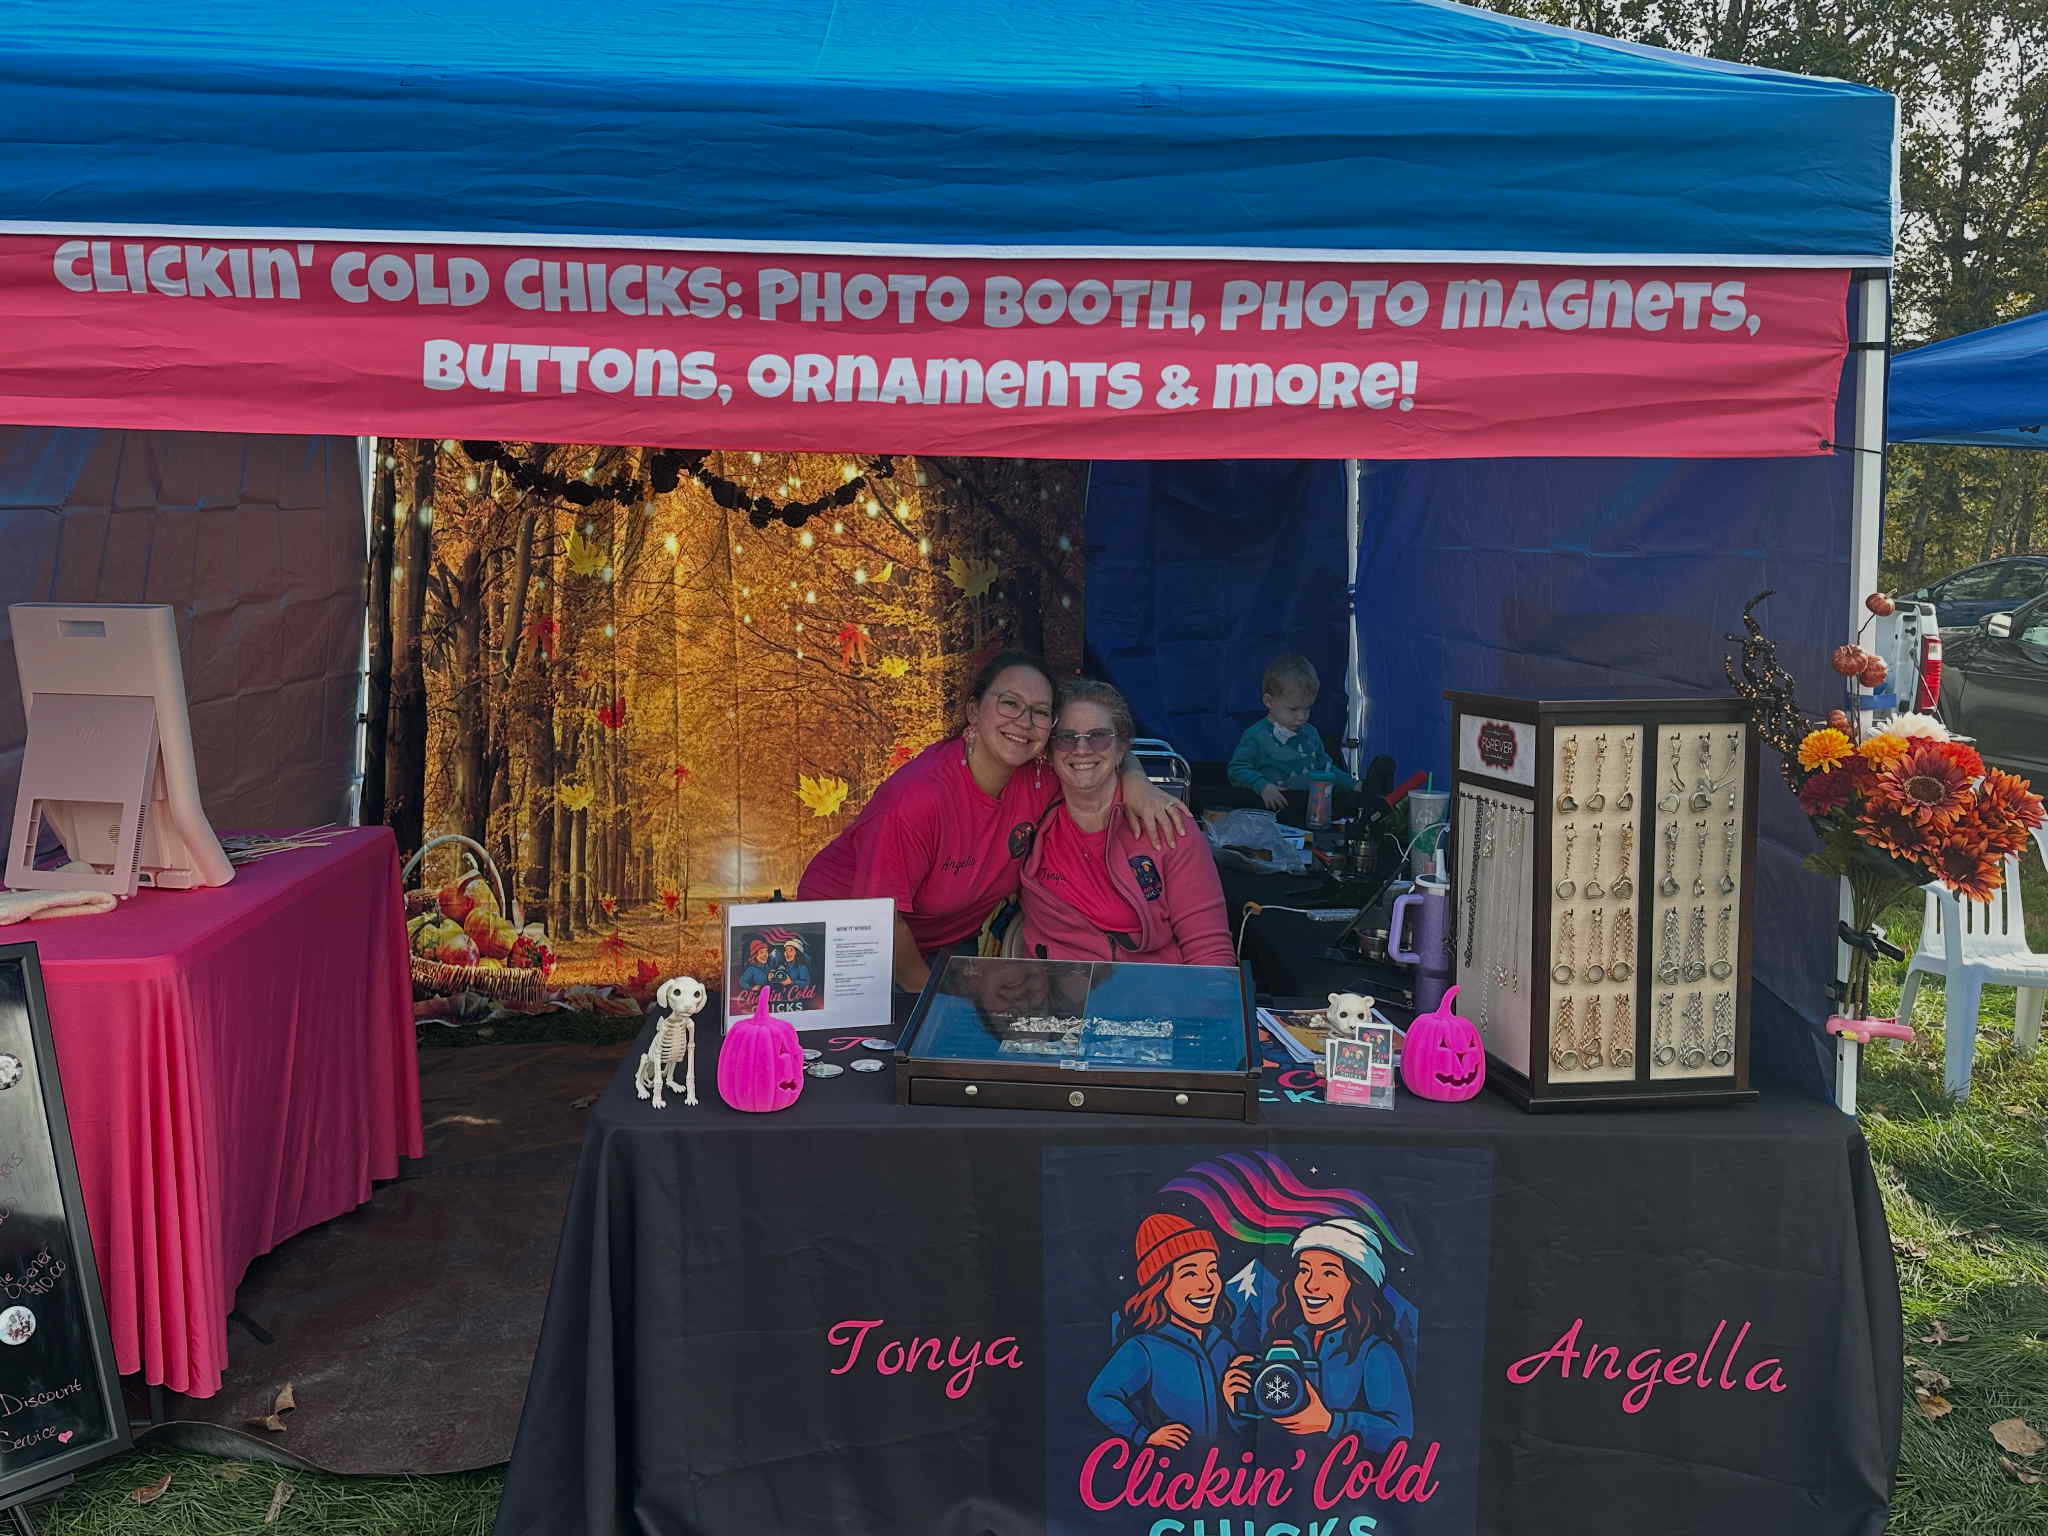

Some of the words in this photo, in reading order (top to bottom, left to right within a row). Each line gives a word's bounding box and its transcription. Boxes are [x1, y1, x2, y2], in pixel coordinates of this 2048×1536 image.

[330, 251, 490, 306] COLD
[504, 258, 743, 319] CHICKS:
[759, 268, 970, 323] PHOTO
[983, 277, 1206, 333] BOOTH,
[1220, 279, 1429, 331] PHOTO
[1156, 364, 1199, 409] &
[788, 984, 816, 1001] Cold
[827, 1319, 1023, 1399] Tonya
[1506, 1318, 1787, 1413] Angella
[0, 1379, 82, 1418] Discount
[1079, 1437, 1305, 1511] Clickin'
[1313, 1435, 1441, 1511] Cold
